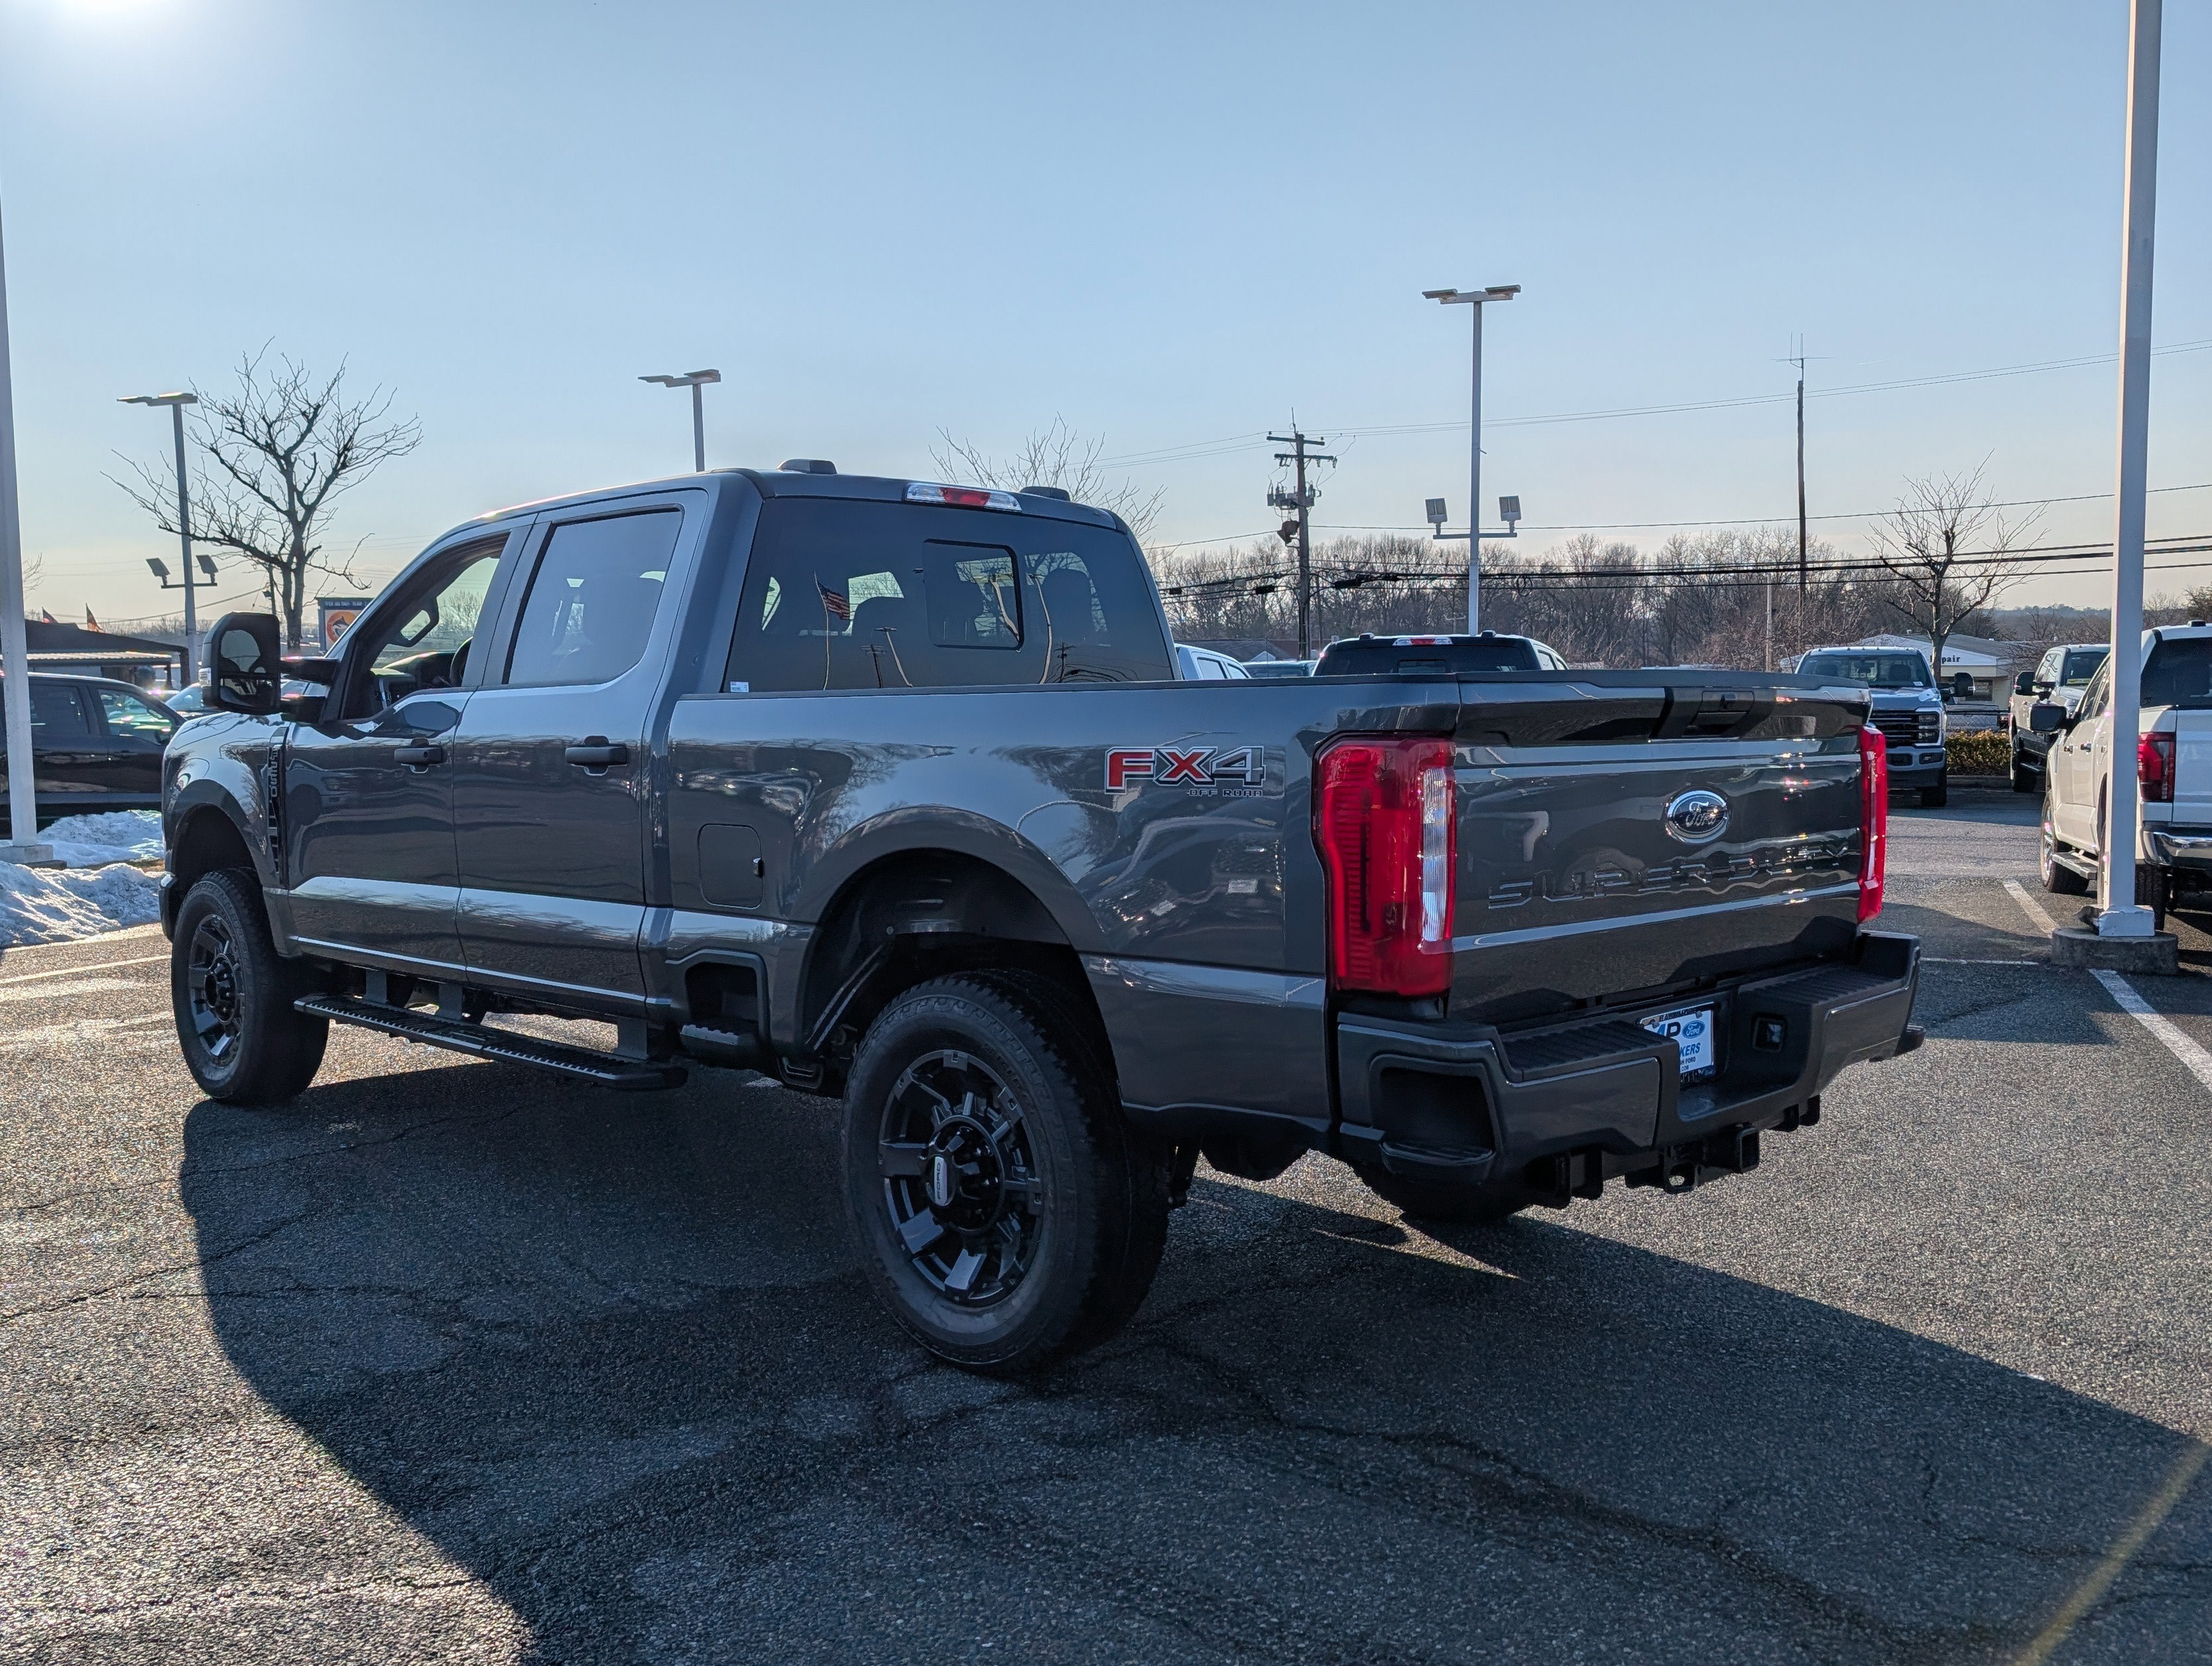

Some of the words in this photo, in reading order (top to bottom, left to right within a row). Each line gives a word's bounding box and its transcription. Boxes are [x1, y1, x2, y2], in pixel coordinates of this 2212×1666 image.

[1930, 655, 1960, 664] pair
[1104, 746, 1266, 795] FX4
[1188, 789, 1218, 797] OFF
[1222, 789, 1263, 797] ROAD
[1685, 800, 1718, 828] Ford
[1488, 862, 1712, 909] SUPER
[1686, 1023, 1702, 1036] Ford
